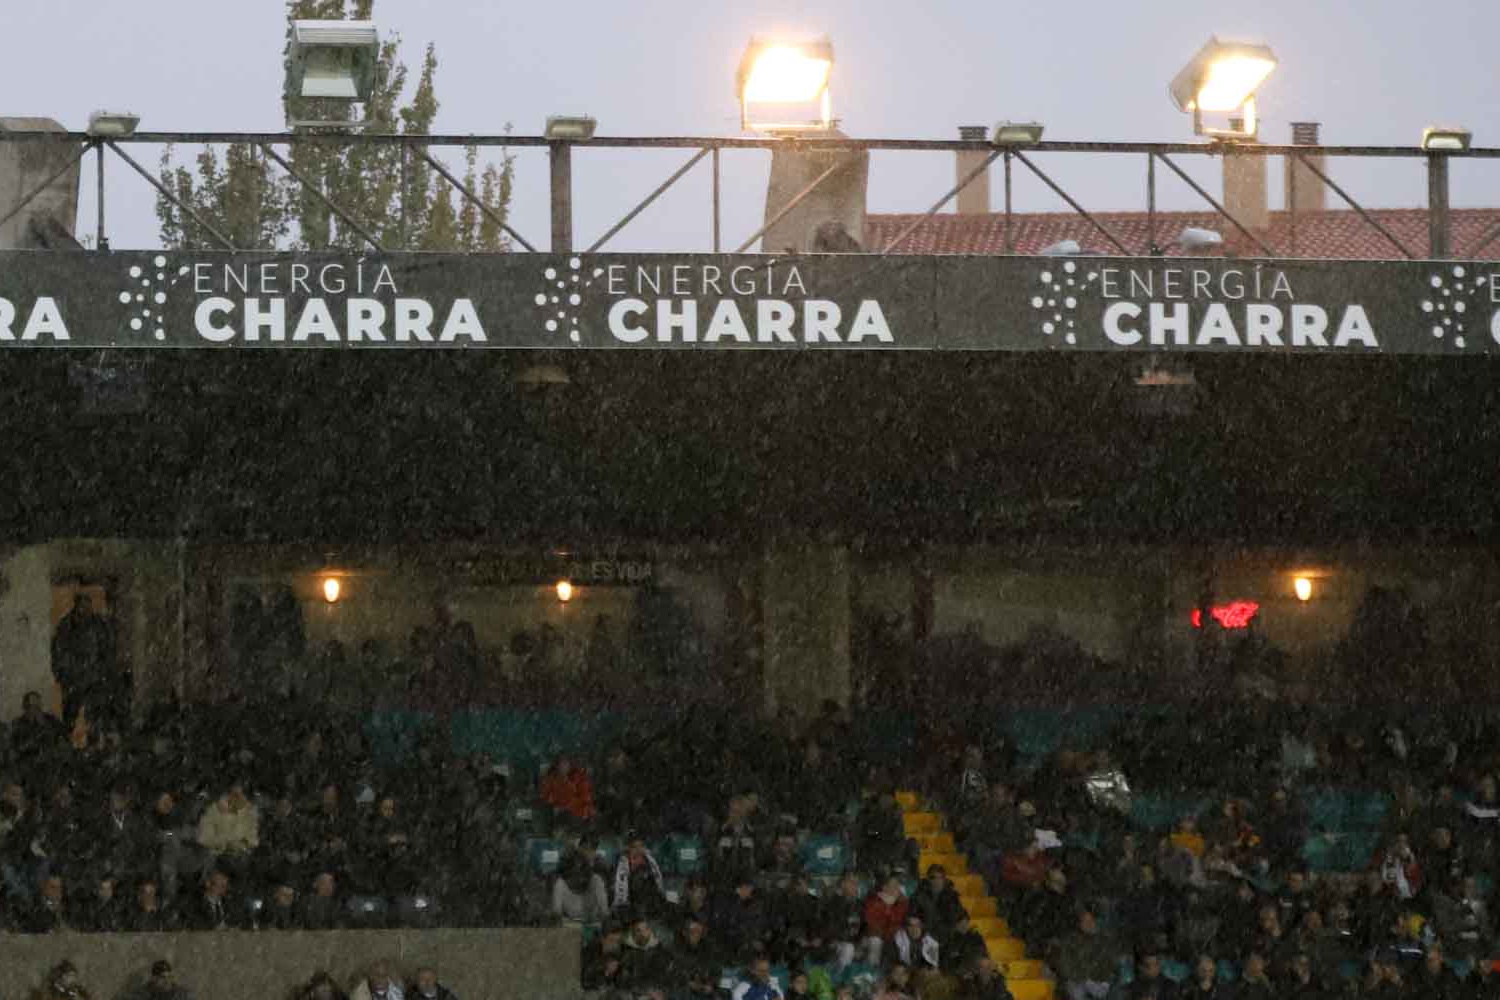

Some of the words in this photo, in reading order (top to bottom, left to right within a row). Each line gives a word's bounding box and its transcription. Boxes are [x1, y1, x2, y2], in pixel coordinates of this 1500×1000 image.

[195, 257, 398, 294] ENERGÍA
[609, 259, 807, 295] ENERGÍA
[1102, 263, 1294, 300] ENERGÍA
[195, 297, 487, 341] CHARRA
[608, 299, 894, 342] CHARRA
[1103, 302, 1379, 347] CHARRA
